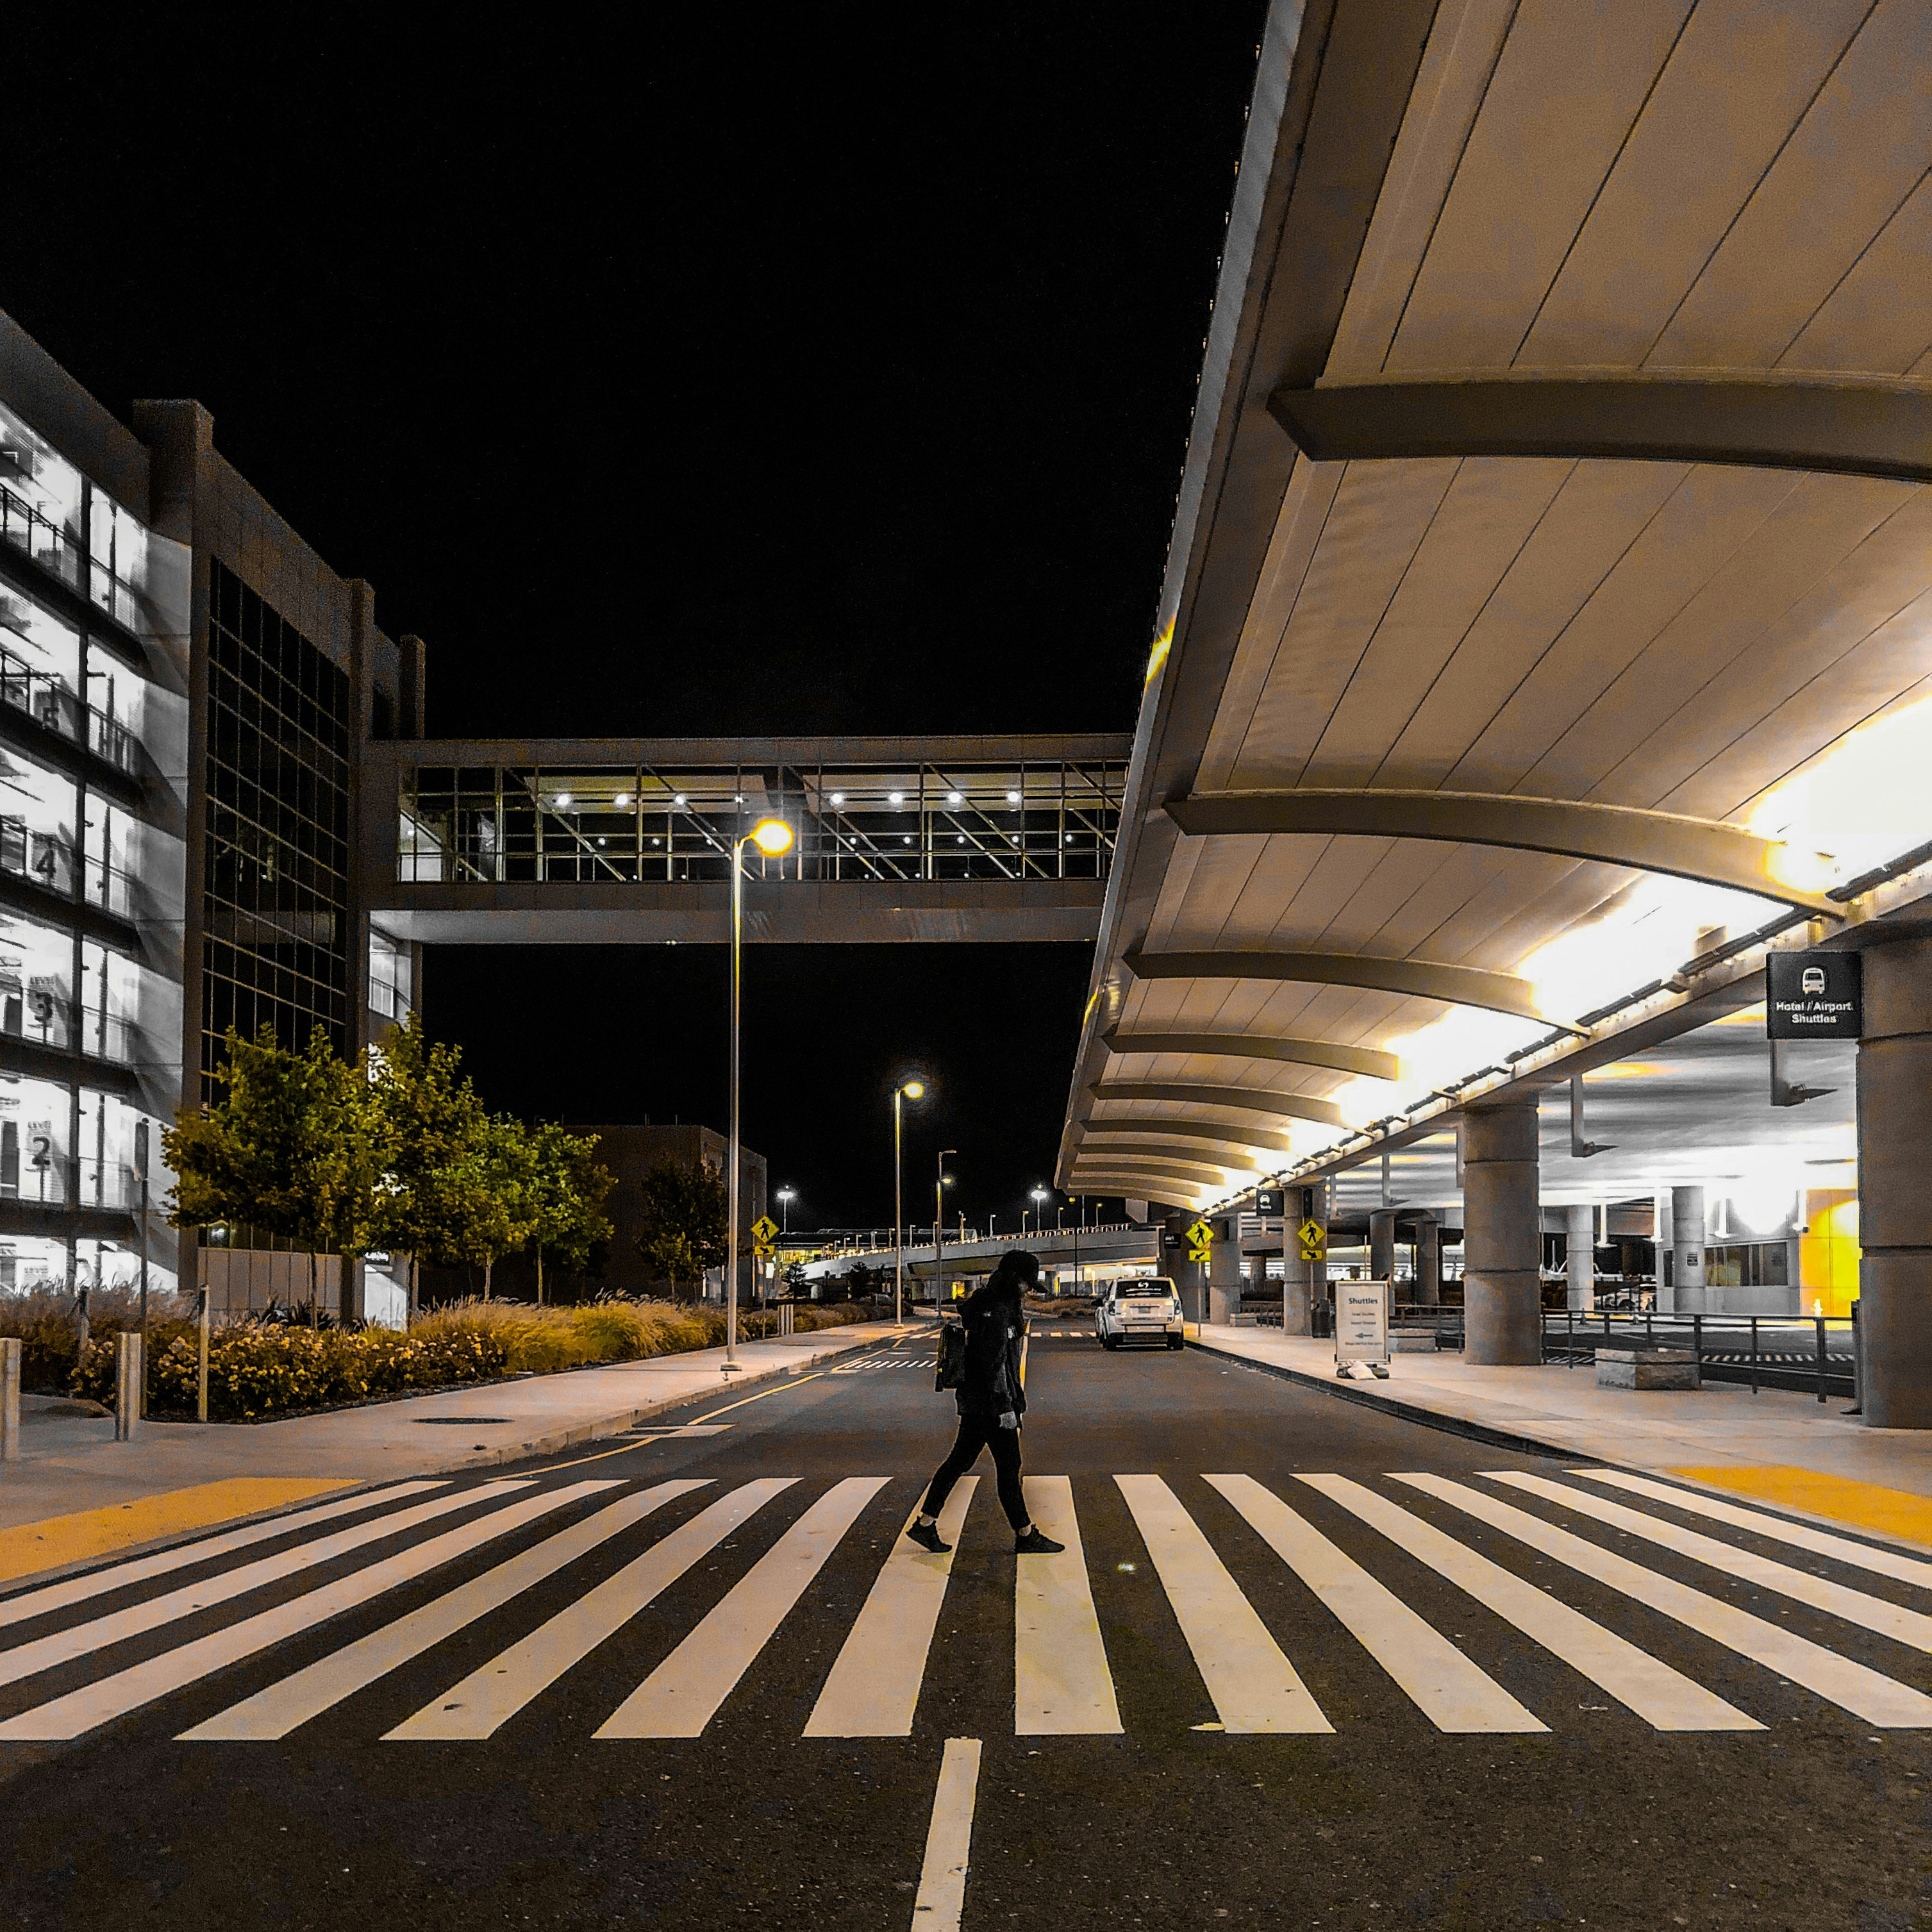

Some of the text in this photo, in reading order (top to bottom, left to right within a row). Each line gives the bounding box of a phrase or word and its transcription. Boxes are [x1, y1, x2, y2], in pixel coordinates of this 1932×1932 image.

[36, 849, 56, 878] 4
[34, 992, 53, 1021] 3
[1776, 1001, 1804, 1011] Hotel
[1813, 1001, 1852, 1013] Airport
[1792, 1013, 1837, 1023] Shuttles
[31, 1136, 50, 1165] 2
